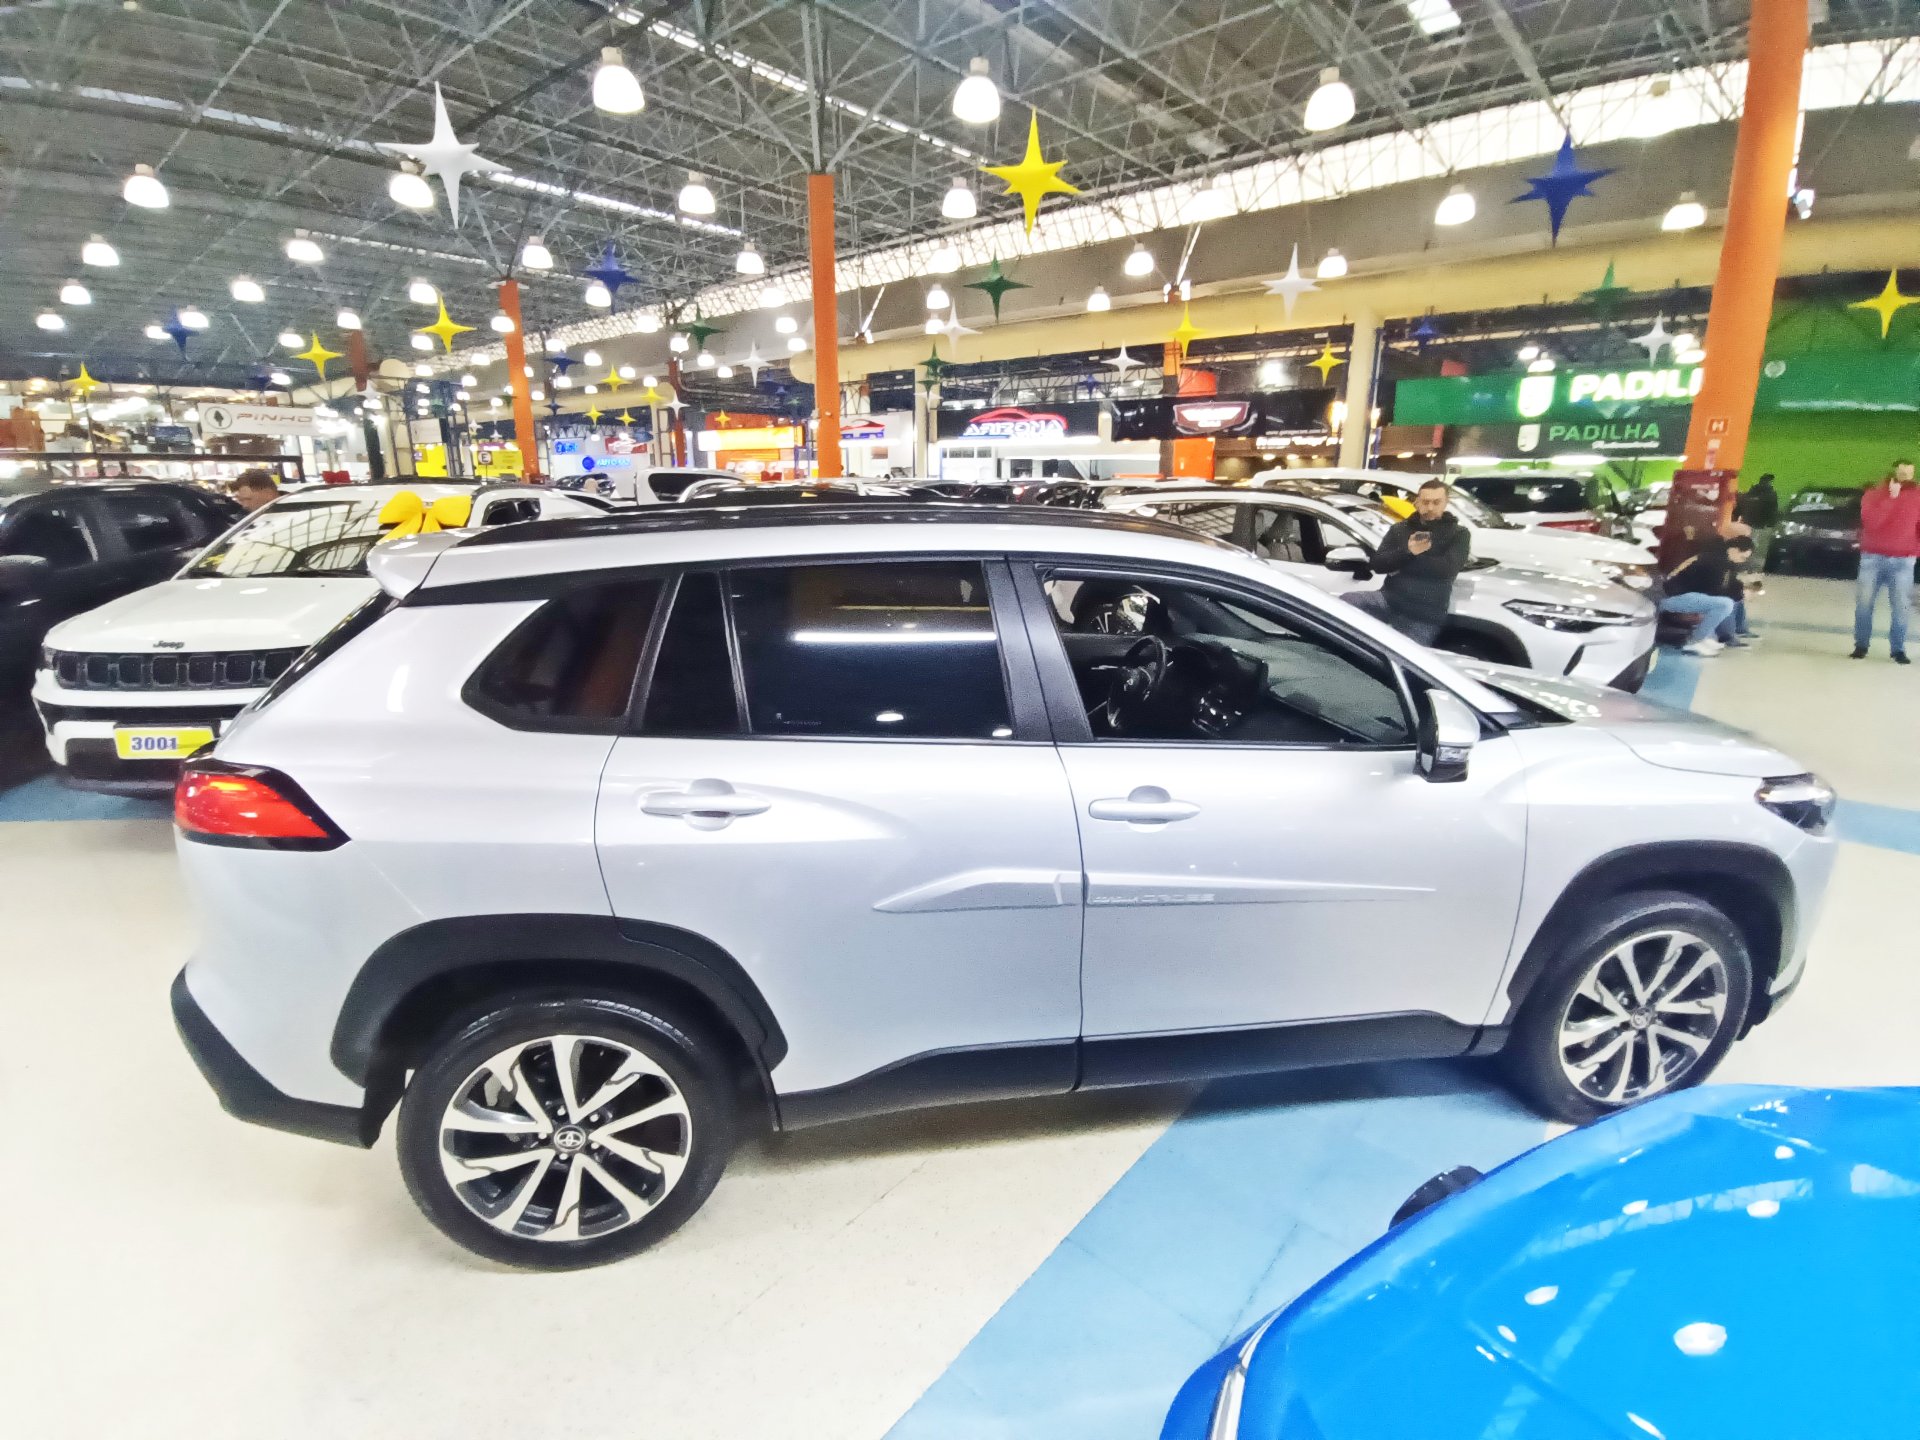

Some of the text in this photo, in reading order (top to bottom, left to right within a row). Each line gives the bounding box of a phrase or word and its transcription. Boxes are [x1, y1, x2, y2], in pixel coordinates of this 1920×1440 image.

[237, 413, 313, 422] PINHO
[963, 420, 1064, 436] ARIZONA
[1711, 421, 1723, 431] H
[1549, 422, 1660, 441] PADILHA
[481, 453, 489, 462] E
[153, 640, 185, 649] Jeep
[131, 737, 178, 751] 3001
